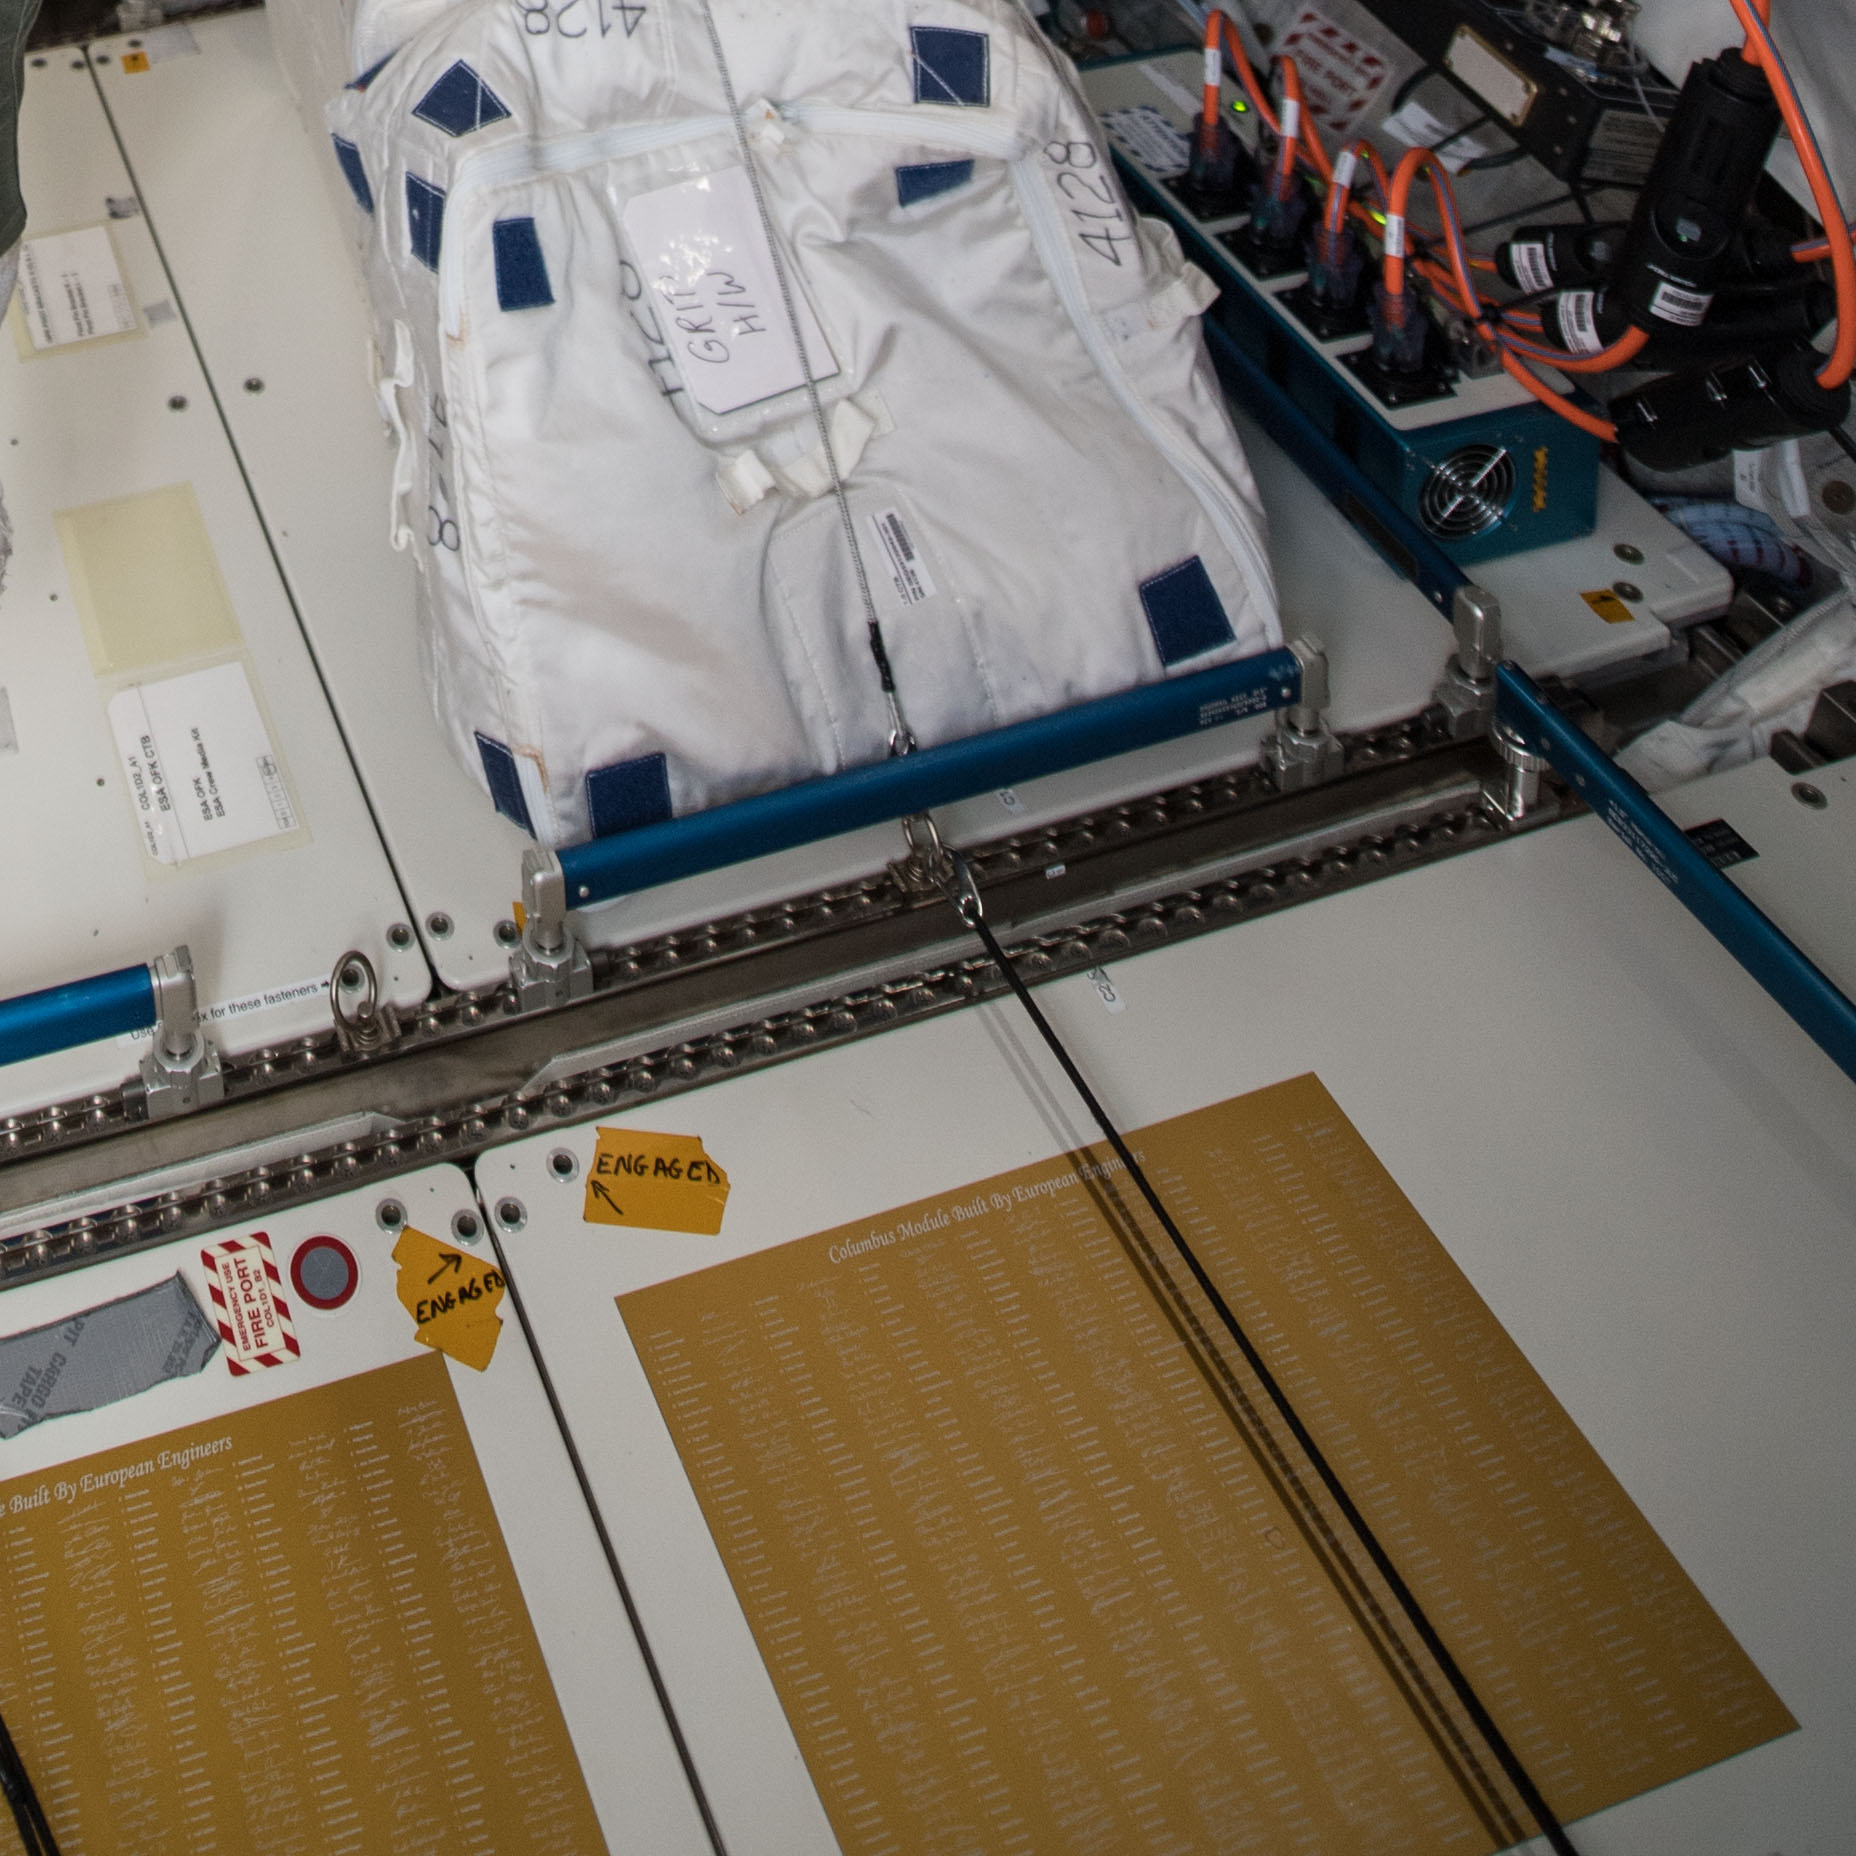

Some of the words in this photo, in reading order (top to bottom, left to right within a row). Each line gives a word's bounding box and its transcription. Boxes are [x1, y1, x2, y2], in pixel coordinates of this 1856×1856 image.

[1039, 129, 1135, 275] 4128
[141, 732, 156, 759] CTB
[155, 785, 169, 812] ESA
[200, 798, 213, 822] ESA
[212, 795, 225, 818] ESA
[209, 1006, 226, 1019] for
[228, 997, 262, 1015] these
[263, 982, 319, 1006] fasteners
[595, 1147, 723, 1190] ENGAGED
[827, 1225, 898, 1264] Columbus
[895, 1207, 952, 1241] Module
[950, 1193, 990, 1221] Built
[987, 1187, 1013, 1211] By
[1011, 1166, 1080, 1204] European
[1079, 1147, 1146, 1182] Enginrs
[222, 1261, 235, 1284] USE
[235, 1255, 257, 1305] PORT
[228, 1285, 250, 1351] EMERGENCY
[411, 1268, 506, 1326] ENGAGED
[247, 1305, 267, 1349] FIRE
[10, 1363, 43, 1408] TAPE
[29, 1351, 68, 1408] CARGO
[6, 1483, 53, 1513] Built
[51, 1475, 80, 1502] By
[78, 1453, 158, 1494] European
[155, 1429, 235, 1471] Engineers
